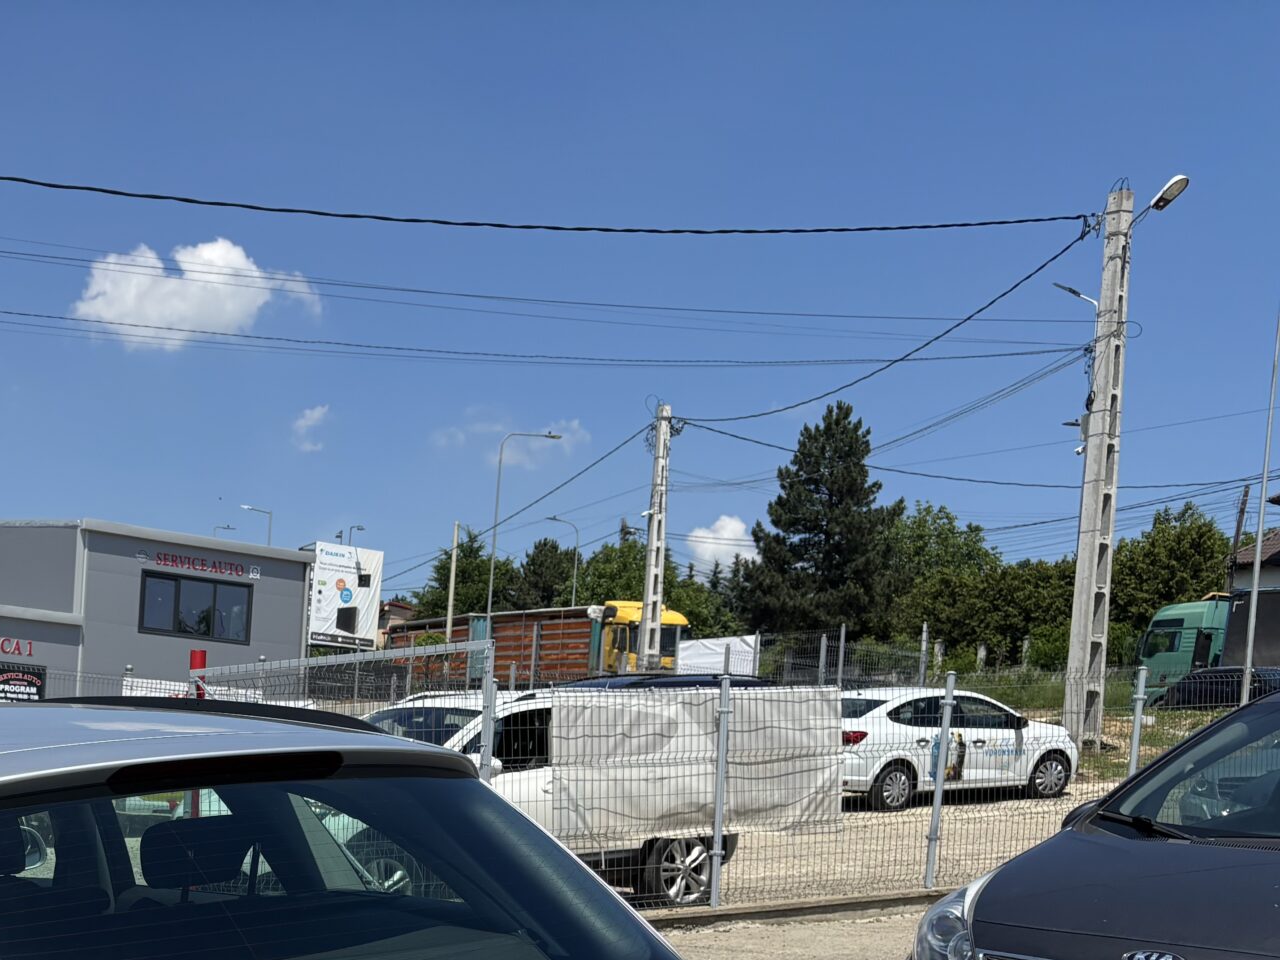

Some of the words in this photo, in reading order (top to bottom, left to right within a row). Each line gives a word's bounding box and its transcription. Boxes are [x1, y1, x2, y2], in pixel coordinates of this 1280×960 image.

[155, 551, 208, 570] SERVICE
[209, 561, 245, 577] AUTO
[0, 684, 37, 694] PROGRAM
